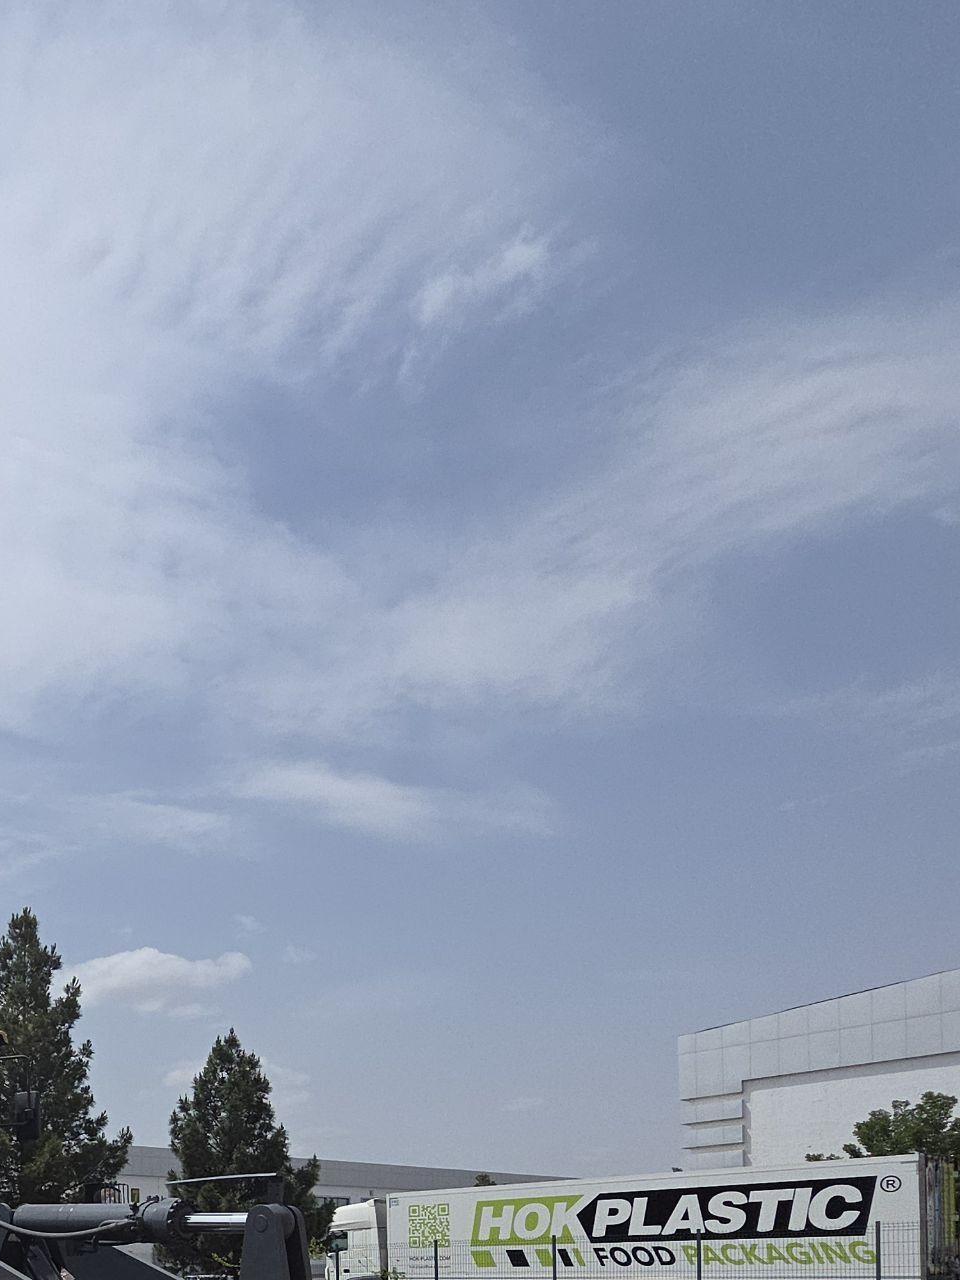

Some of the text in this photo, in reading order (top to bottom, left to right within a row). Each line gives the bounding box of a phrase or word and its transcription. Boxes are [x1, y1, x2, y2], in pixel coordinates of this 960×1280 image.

[477, 1200, 584, 1241] HOK
[592, 1183, 864, 1239] PLASTIC
[592, 1240, 878, 1267] FOOD PACKAGING
